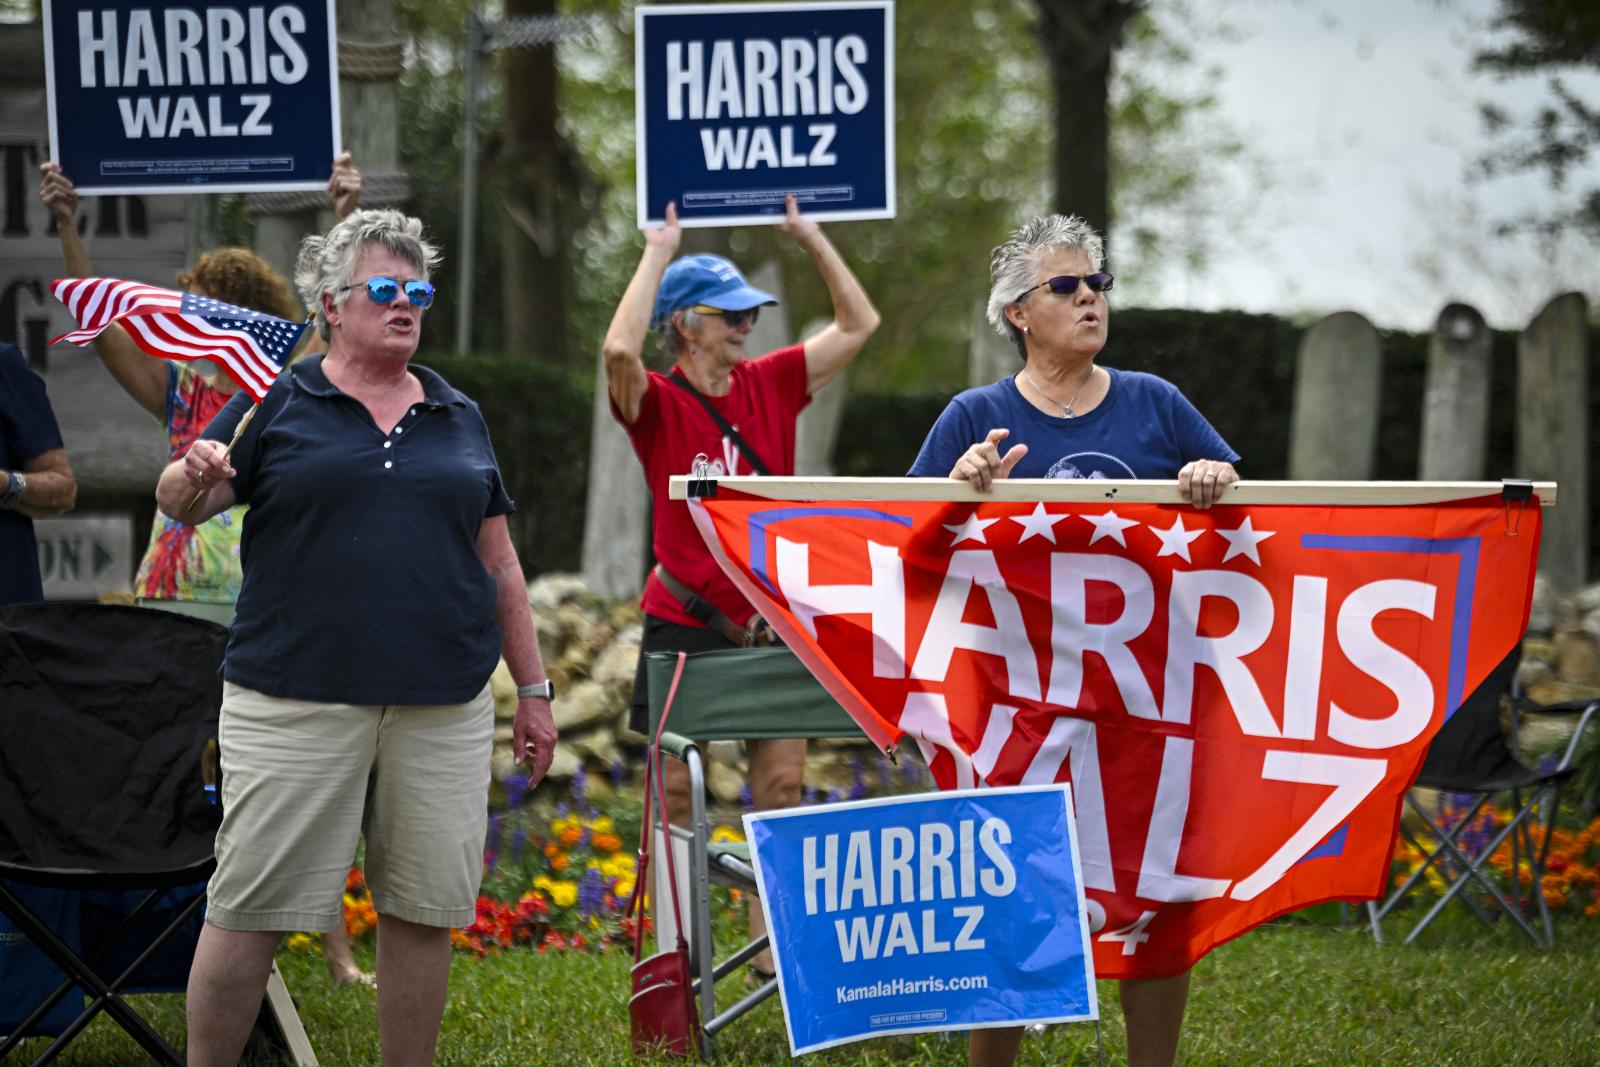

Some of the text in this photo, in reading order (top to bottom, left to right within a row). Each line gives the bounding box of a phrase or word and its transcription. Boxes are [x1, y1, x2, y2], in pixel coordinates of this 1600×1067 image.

[77, 5, 309, 88] HARRIS
[666, 35, 869, 121] HARRIS
[117, 94, 273, 139] WALZ
[700, 123, 837, 171] WALZ
[774, 534, 1438, 750] HARRIS
[803, 817, 1017, 916] HARRIS
[834, 905, 986, 963] WALZ
[836, 974, 988, 1004] KamalaHarris.com
